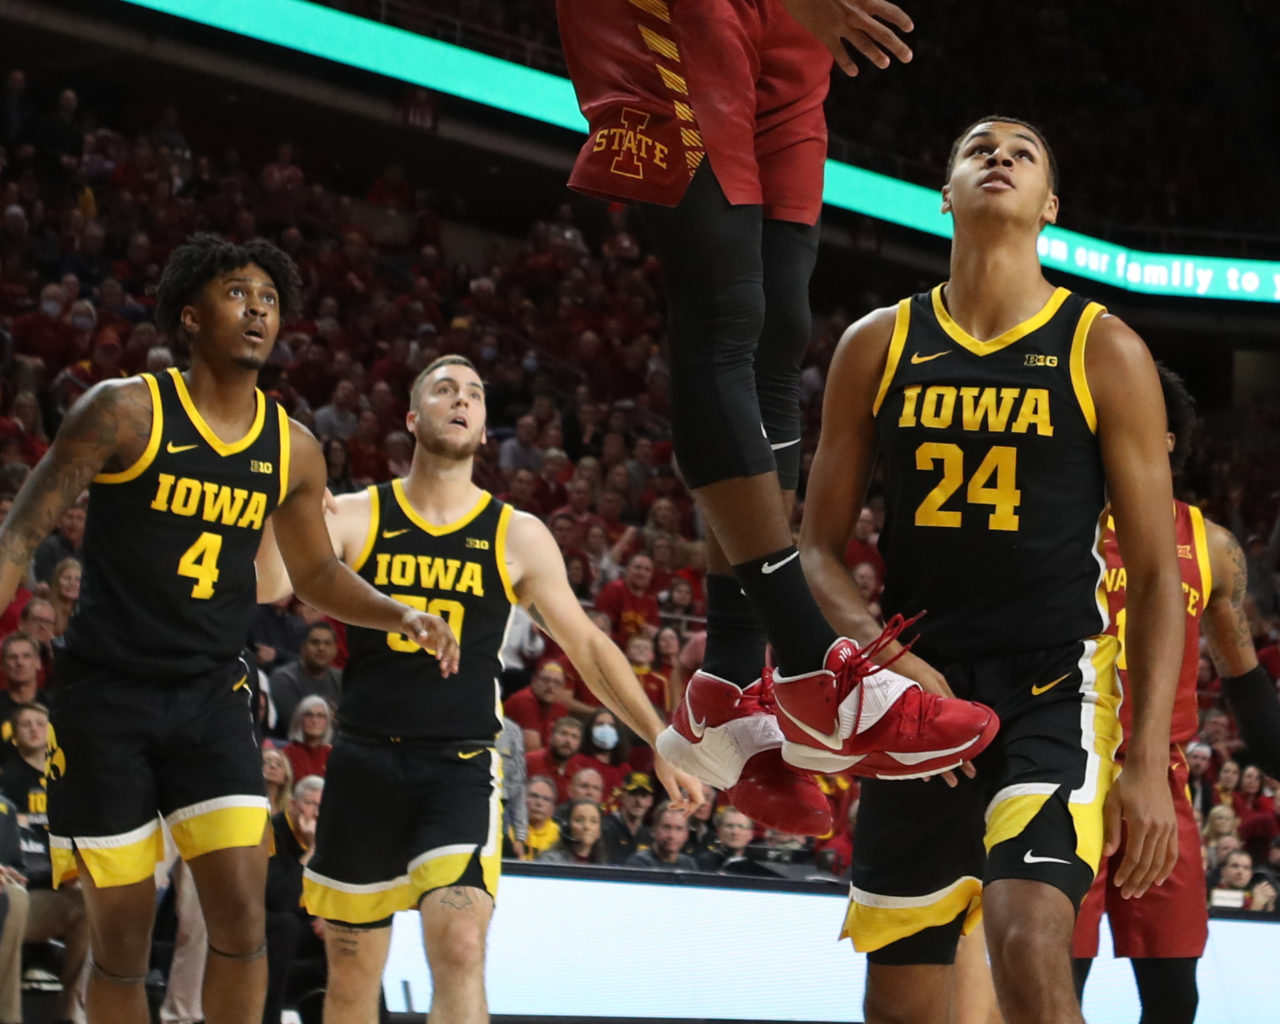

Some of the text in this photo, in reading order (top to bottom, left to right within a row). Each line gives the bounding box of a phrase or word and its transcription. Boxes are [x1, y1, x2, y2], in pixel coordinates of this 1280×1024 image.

[592, 127, 669, 170] STATE
[1036, 235, 1068, 263] om
[1074, 246, 1109, 274] our
[1115, 251, 1214, 296] family
[1226, 266, 1260, 292] to
[898, 384, 1054, 437] IOWA
[150, 472, 268, 530] IOWA
[914, 442, 1021, 531] 24
[177, 531, 223, 600] 4
[374, 553, 485, 598] IOWA
